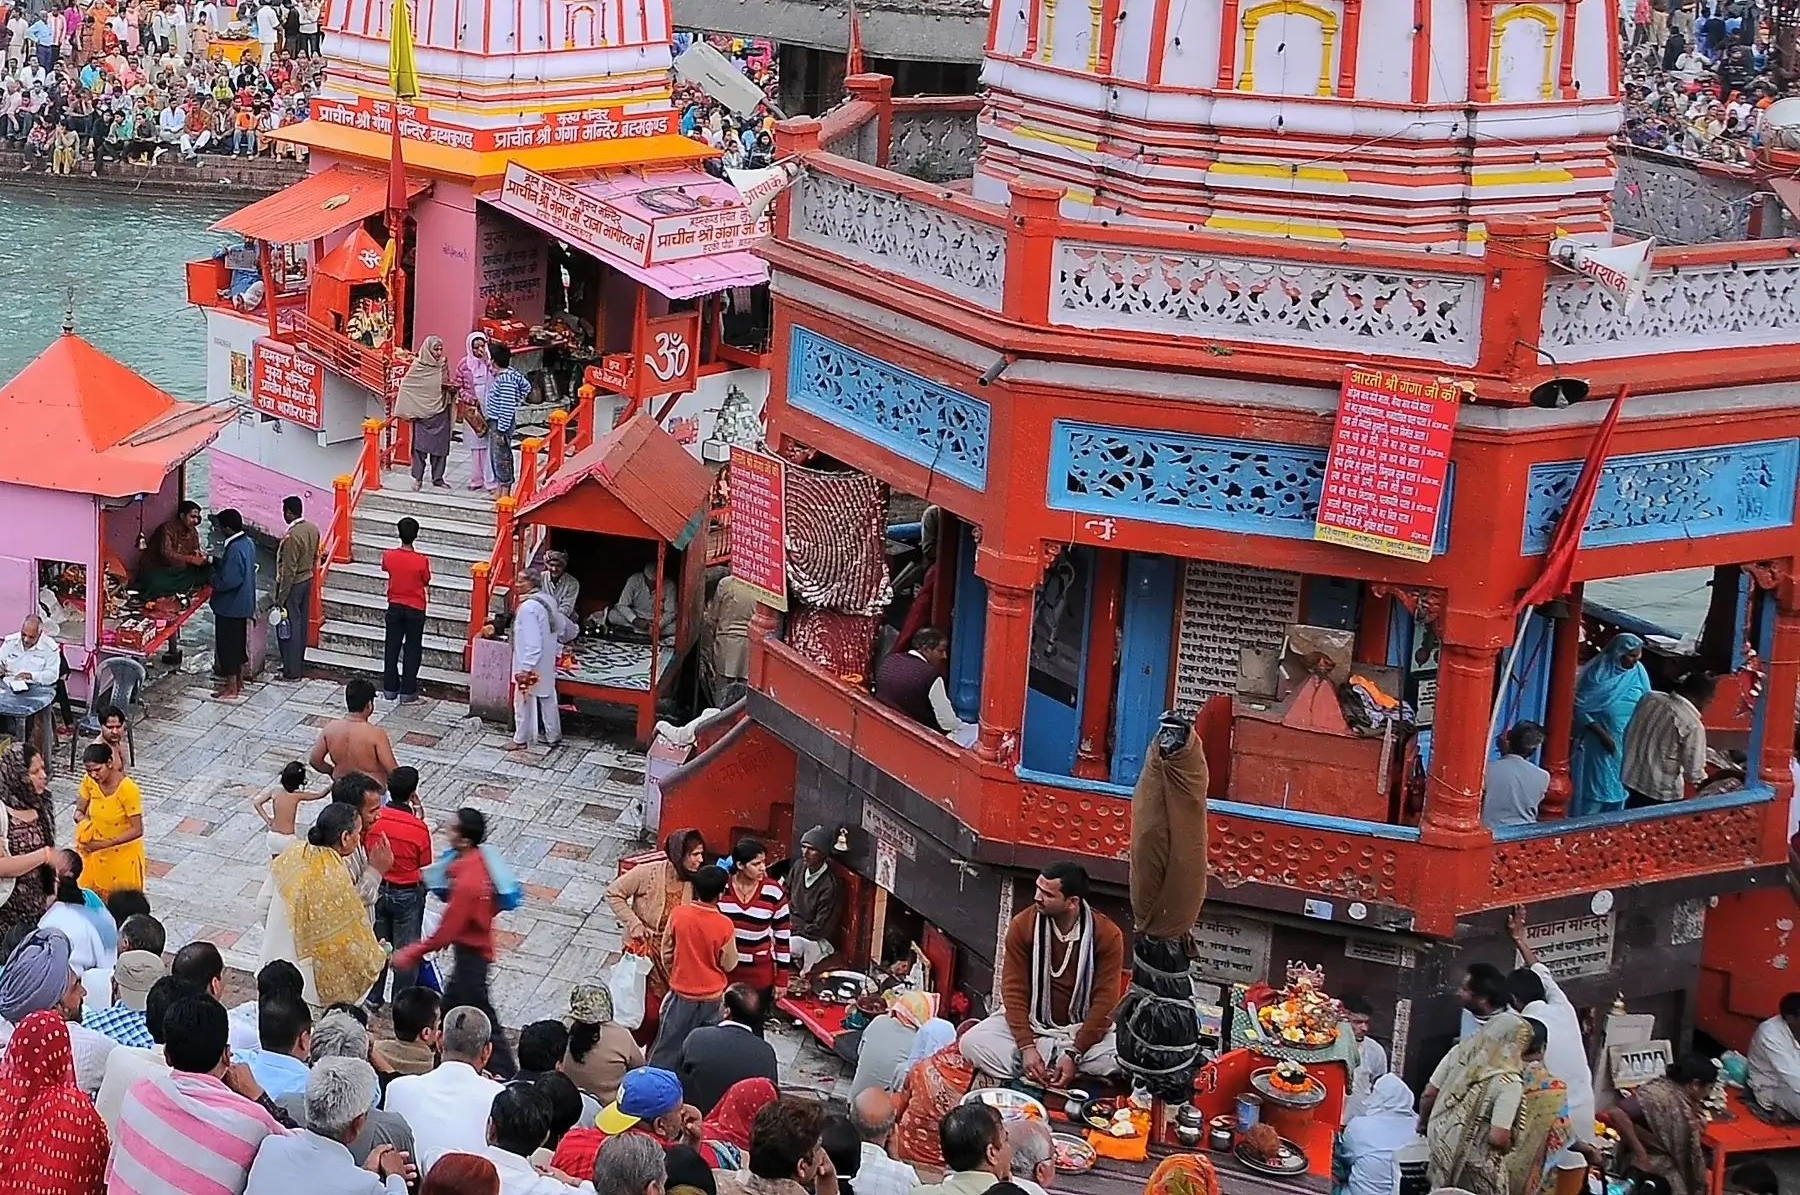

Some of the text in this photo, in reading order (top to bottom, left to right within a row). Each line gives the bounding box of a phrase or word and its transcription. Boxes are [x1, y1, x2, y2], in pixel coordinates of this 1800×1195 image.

[318, 104, 354, 127] प्राचीन
[356, 110, 371, 130] श्री
[372, 114, 392, 133] गंगा
[494, 127, 535, 148] प्राचीन
[536, 124, 551, 144] श्री
[554, 123, 579, 142] गंगा
[582, 120, 620, 141] मन्दिर
[506, 180, 538, 203] प्राचीन
[538, 192, 549, 210] श्री
[550, 199, 571, 218] गंगा
[570, 206, 582, 223] जी
[583, 214, 604, 236] राजा
[633, 233, 645, 253] जी
[657, 228, 696, 248] प्राचीन
[698, 224, 714, 242] श्री
[715, 223, 742, 240] गंगा
[305, 388, 316, 407] जी
[1350, 370, 1457, 402] आरती श्री गंगा जी की
[306, 406, 317, 424] जी
